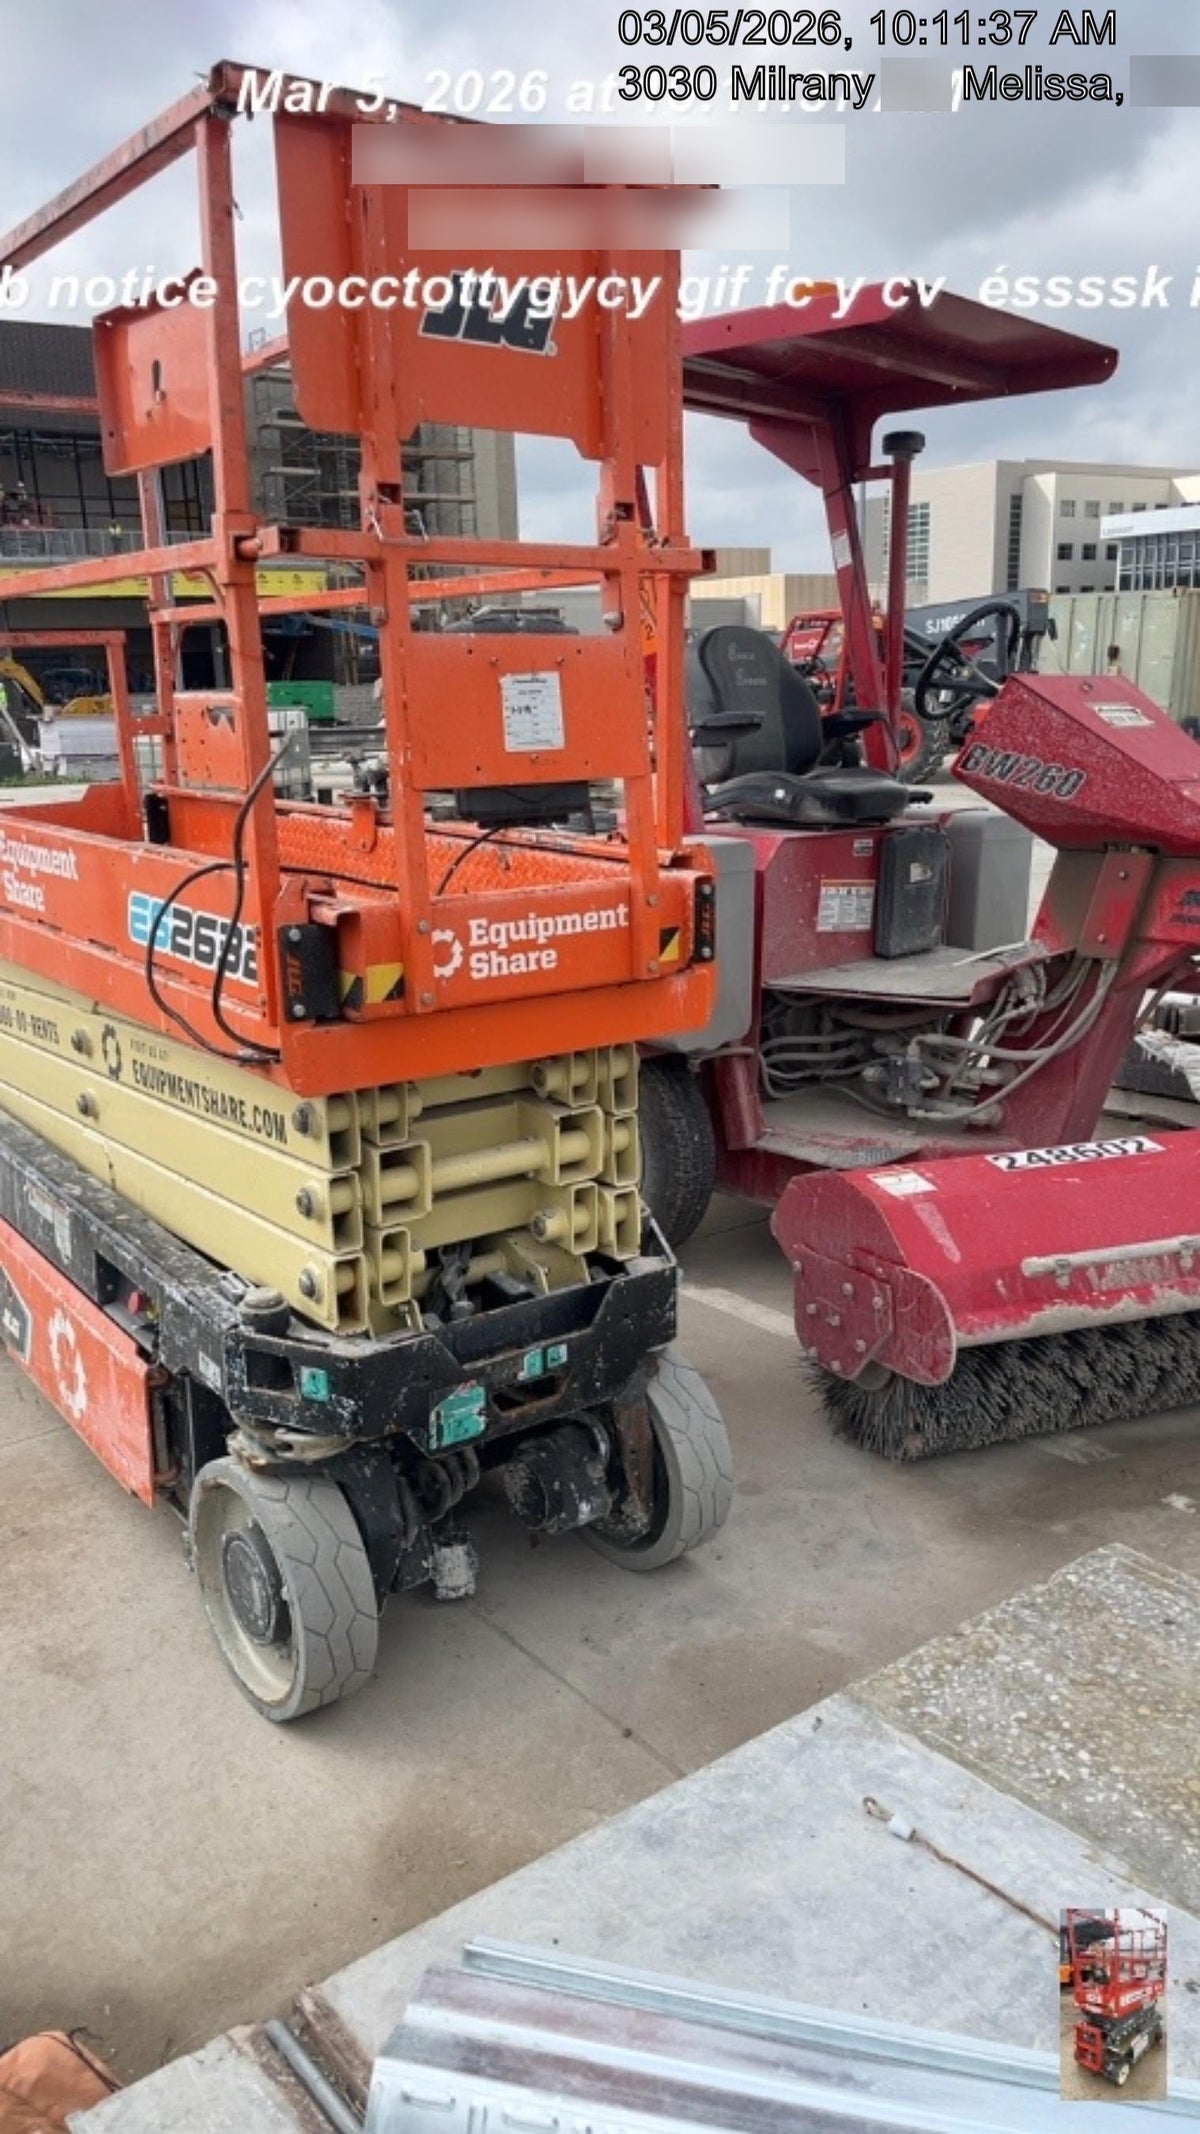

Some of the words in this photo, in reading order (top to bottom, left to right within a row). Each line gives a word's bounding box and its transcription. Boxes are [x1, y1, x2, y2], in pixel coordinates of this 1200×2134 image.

[418, 269, 560, 356] JLG
[959, 743, 1088, 800] BW260
[3, 869, 46, 912] Share
[468, 902, 630, 948] Equipment
[469, 947, 559, 980] Share
[131, 1058, 288, 1145] EQUIPMENTSHARE.COM
[991, 1138, 1151, 1170] 248602
